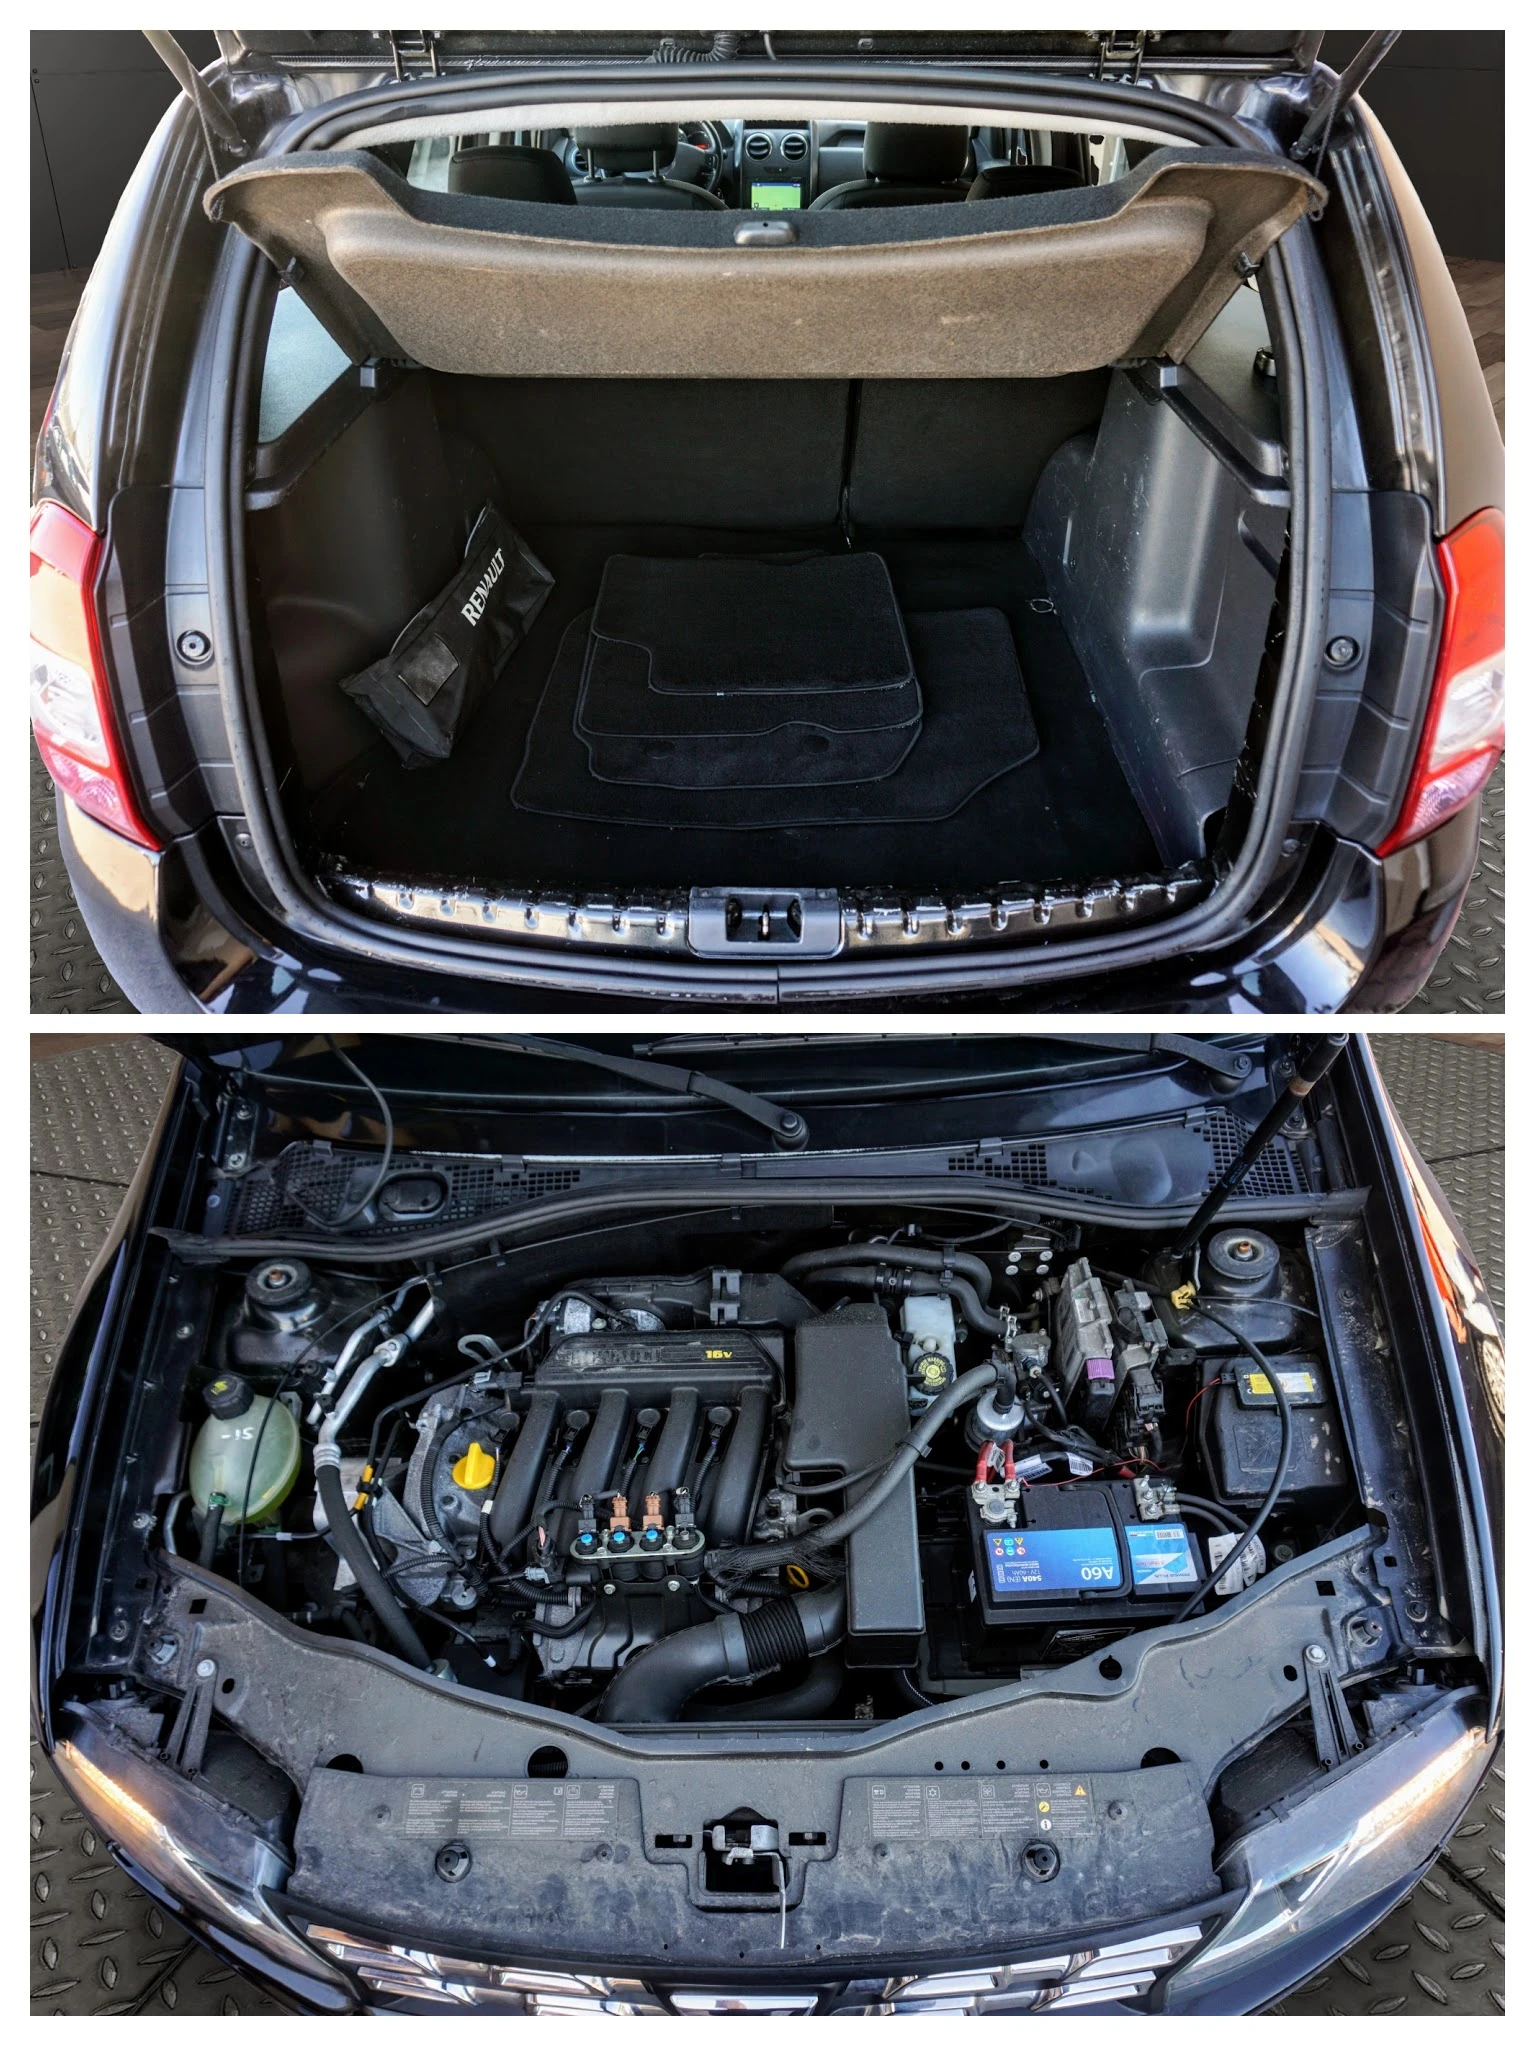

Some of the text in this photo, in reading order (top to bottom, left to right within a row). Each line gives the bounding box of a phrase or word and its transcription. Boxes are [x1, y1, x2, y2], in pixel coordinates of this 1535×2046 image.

[461, 547, 505, 626] RENAULT
[1006, 1575, 1021, 1583] (EN)
[1081, 1566, 1114, 1581] A60
